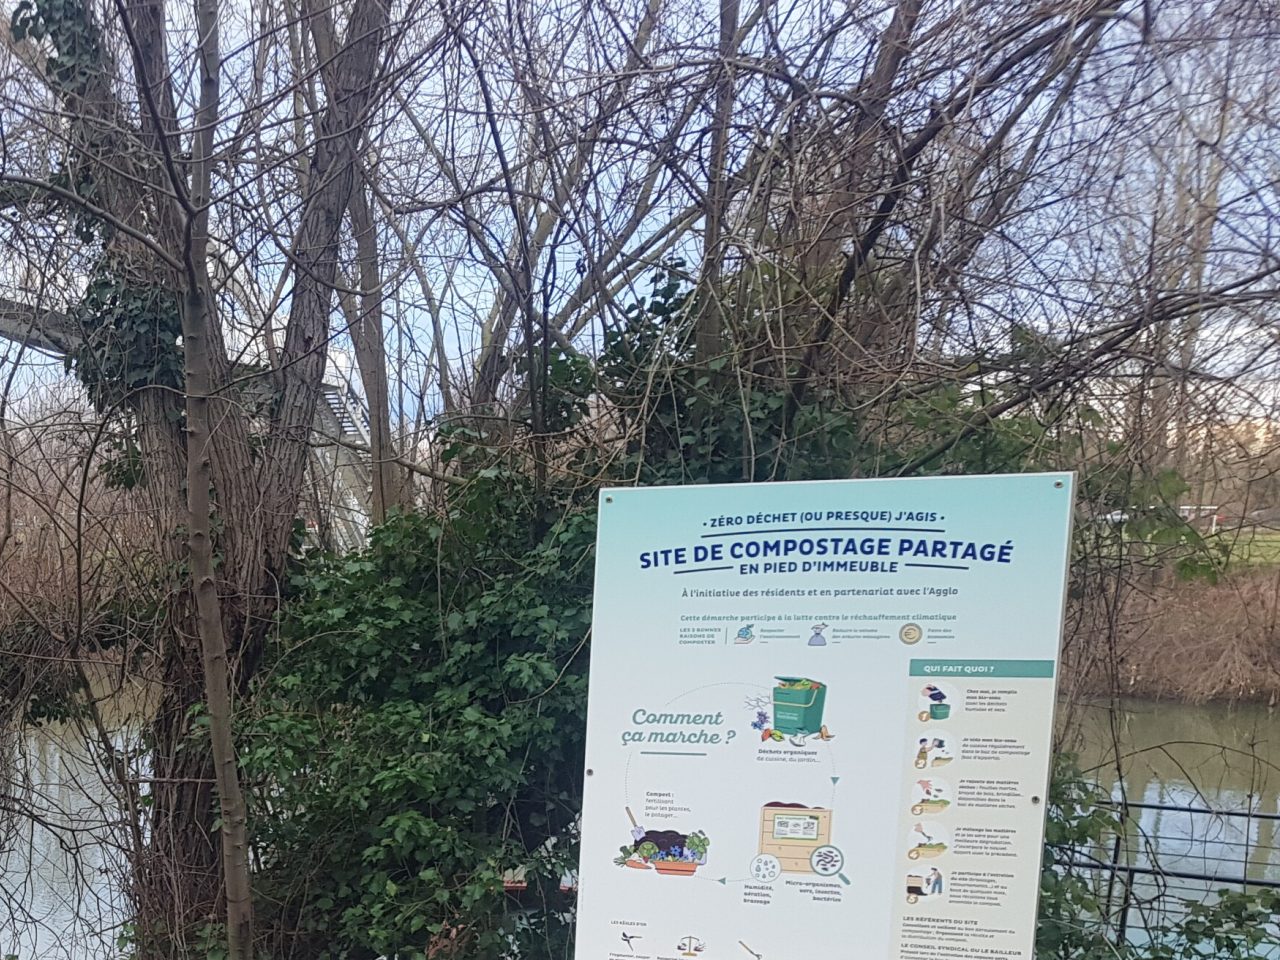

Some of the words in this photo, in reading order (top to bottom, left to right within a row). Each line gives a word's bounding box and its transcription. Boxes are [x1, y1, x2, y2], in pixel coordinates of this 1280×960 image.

[710, 515, 743, 527] ZÉRO
[747, 512, 797, 524] DÉCHET
[800, 511, 822, 523] (OU
[827, 511, 892, 523] PRESQUE)
[895, 511, 937, 522] J'AGIS
[639, 548, 687, 569] SITE
[694, 544, 723, 562] DE
[730, 538, 892, 559] COMPOSTAGE
[898, 539, 1014, 563] PARTAGÉ
[740, 563, 759, 575] EN
[763, 562, 797, 573] PIED
[802, 561, 898, 573] D'IMMEUBLE
[682, 588, 688, 597] À
[690, 588, 742, 597] l'initiative
[744, 588, 759, 597] des
[761, 588, 805, 597] résidents
[834, 588, 894, 598] partenariat
[896, 588, 921, 596] avec
[923, 587, 959, 597] l'Agglo
[702, 614, 739, 622] démarche
[740, 614, 776, 622] participe
[850, 614, 910, 622] réchauffement
[912, 613, 957, 622] climatique
[923, 665, 940, 673] QUI
[942, 665, 963, 673] FAIT
[964, 665, 988, 673] QUOI
[632, 708, 724, 726] Comment
[622, 731, 646, 746] ça
[647, 729, 722, 744] marche
[725, 730, 737, 745] ?
